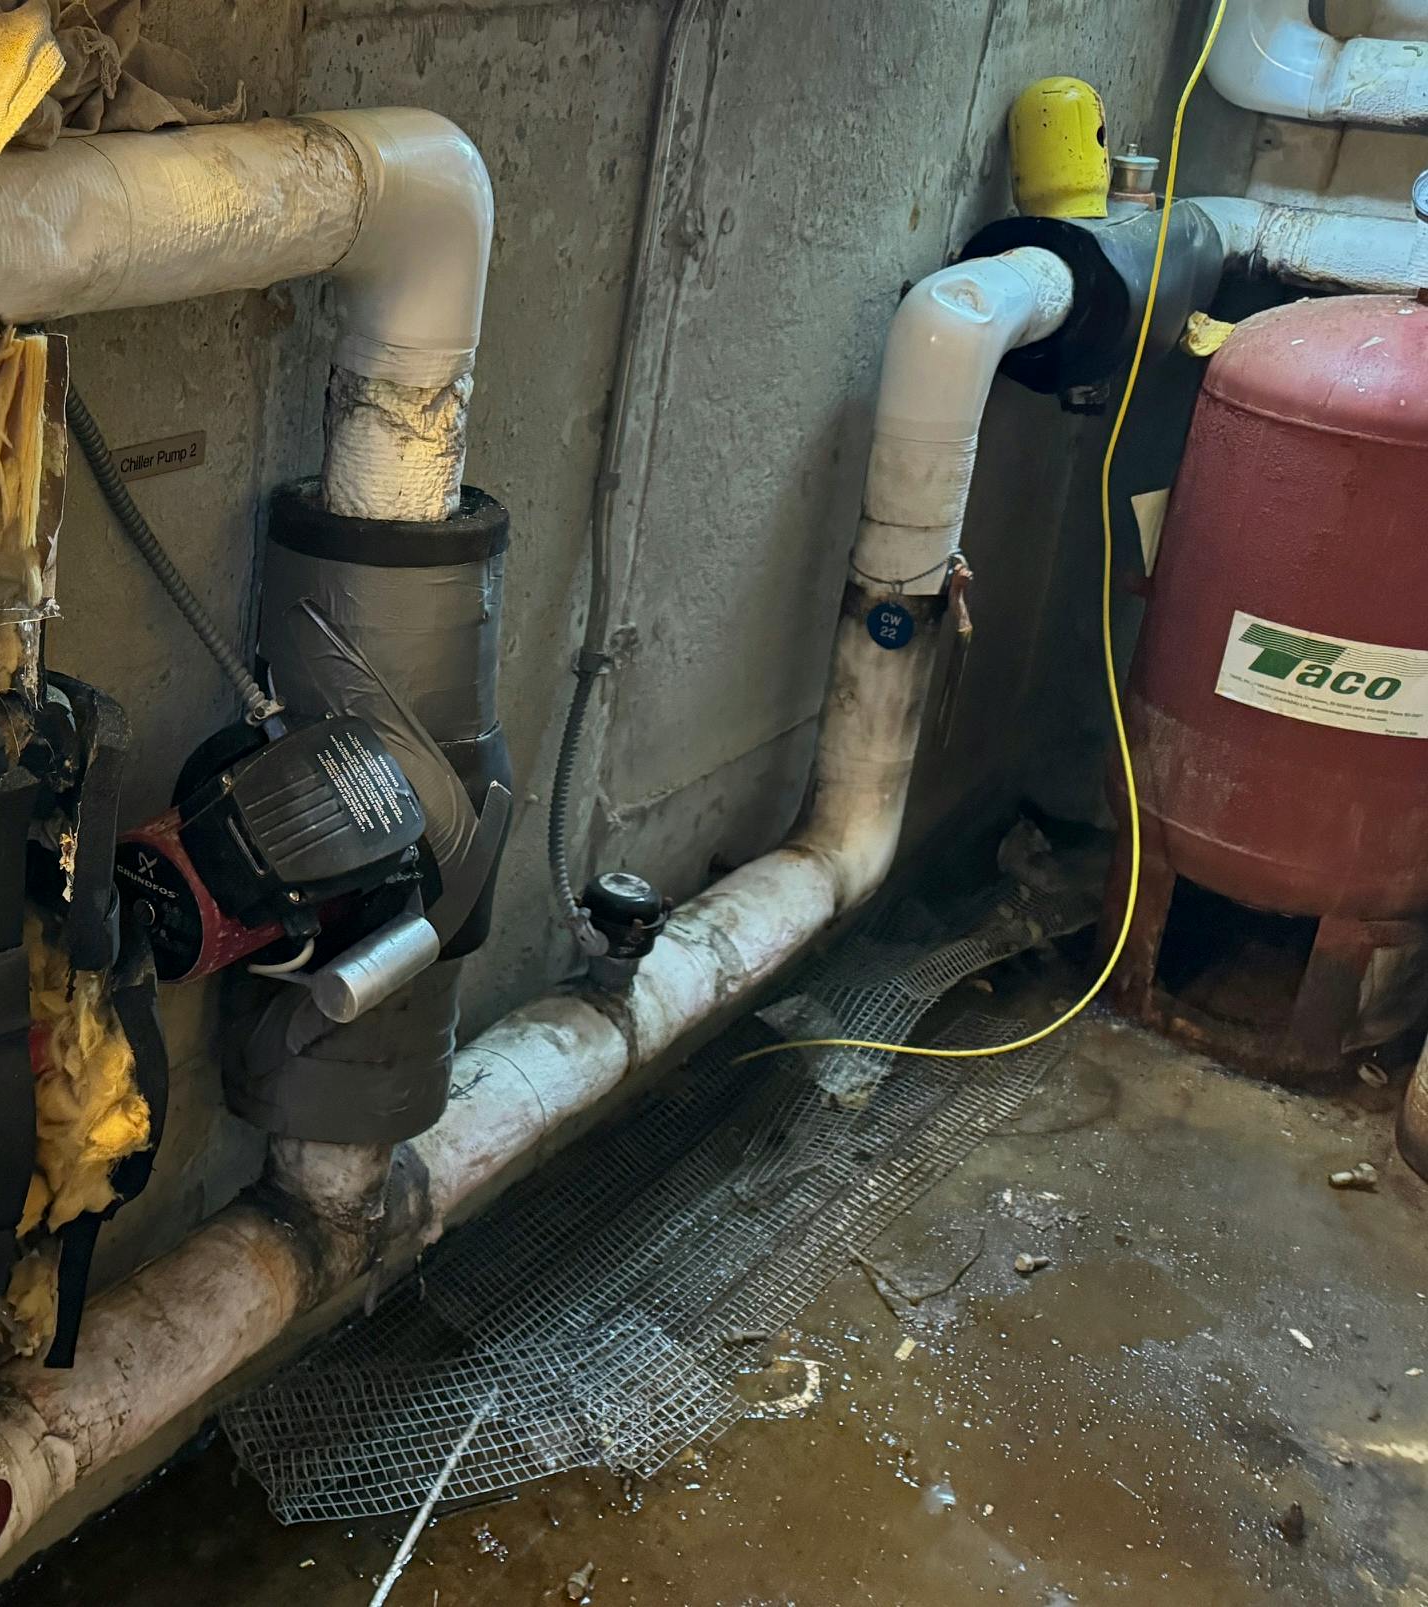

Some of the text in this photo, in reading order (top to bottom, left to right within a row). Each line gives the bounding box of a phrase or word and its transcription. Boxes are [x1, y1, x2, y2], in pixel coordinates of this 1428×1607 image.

[120, 442, 197, 473] Chiller Pump 2
[879, 626, 898, 640] 22
[880, 612, 902, 627] CW
[1239, 623, 1402, 701] Taco
[378, 754, 399, 787] WARNING
[116, 865, 177, 899] GRUNDFOS
